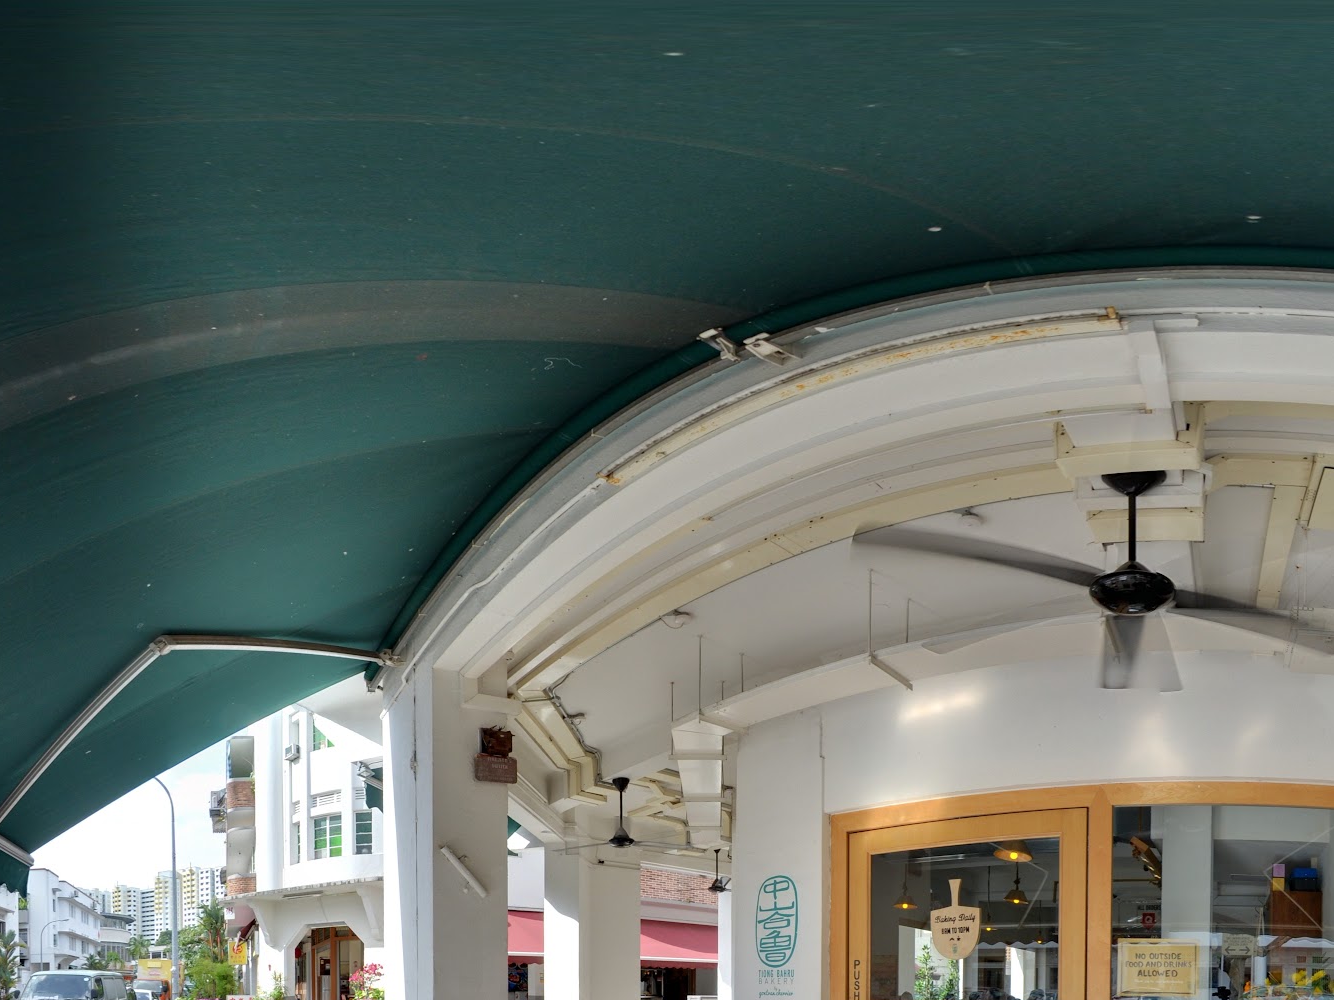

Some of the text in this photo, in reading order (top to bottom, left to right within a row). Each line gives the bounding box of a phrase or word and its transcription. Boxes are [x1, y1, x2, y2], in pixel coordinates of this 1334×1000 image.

[934, 913, 976, 925] Baking Daily
[1135, 952, 1182, 960] NO OUTSIDE
[1125, 960, 1192, 968] FOOD AND DRINKS
[758, 969, 795, 978] TIONG BAHRU
[1137, 969, 1179, 977] ALLOWED
[758, 977, 795, 985] BAKERY
[853, 959, 861, 1000] PUSH
